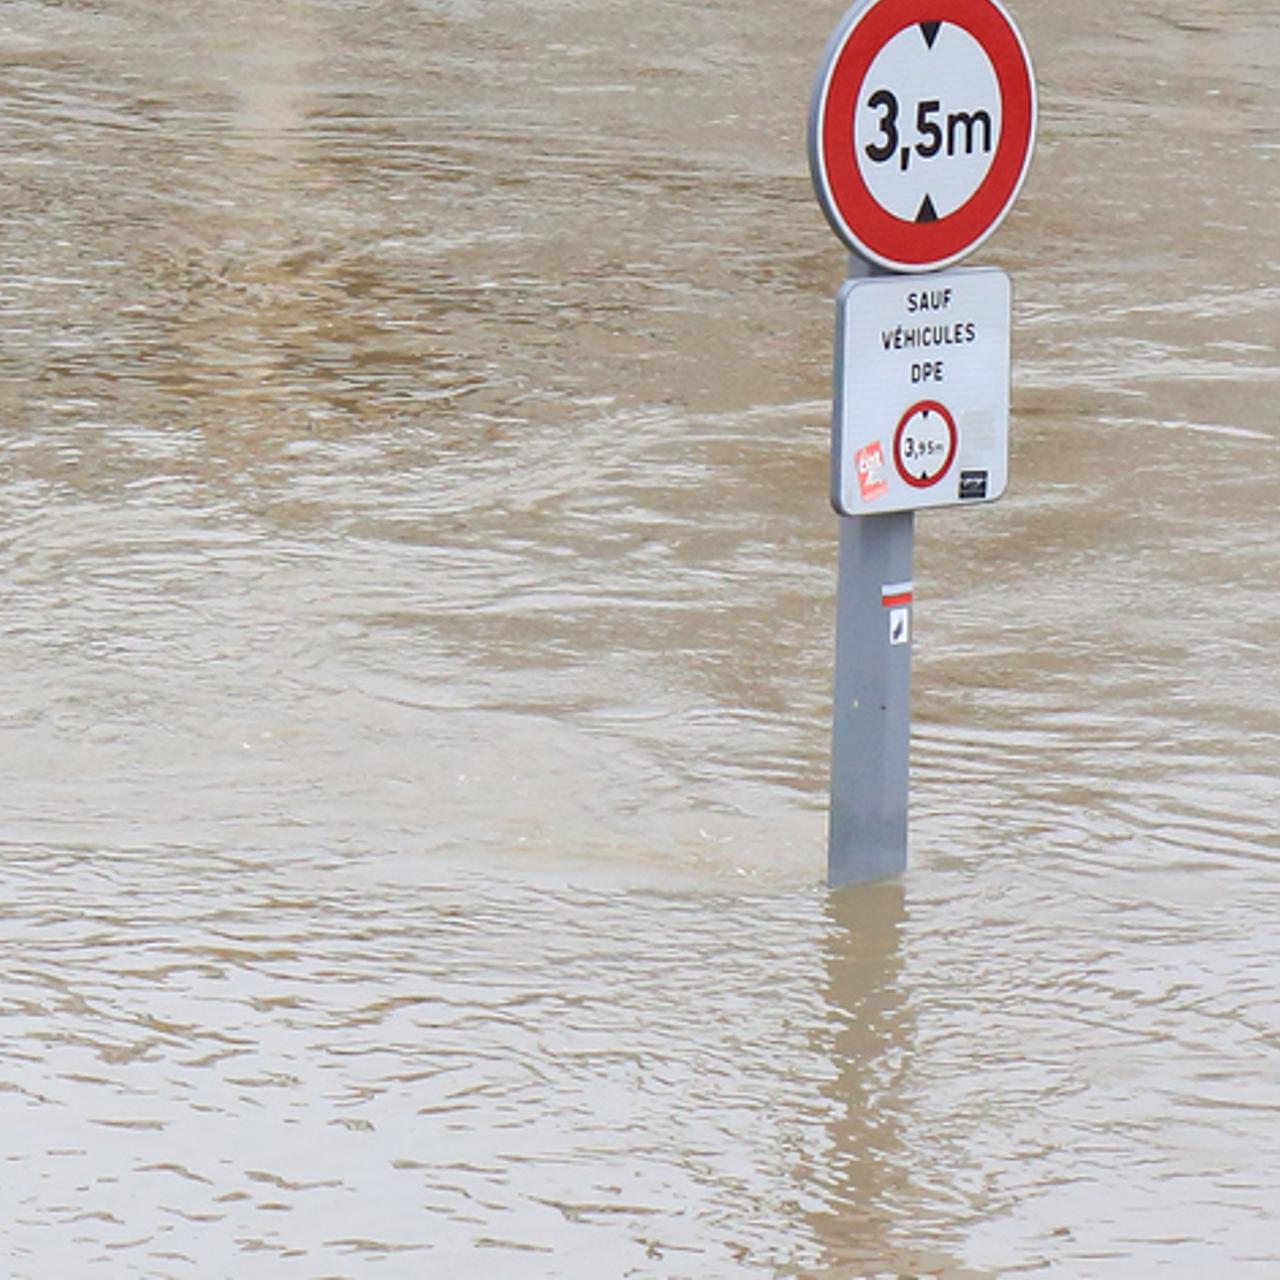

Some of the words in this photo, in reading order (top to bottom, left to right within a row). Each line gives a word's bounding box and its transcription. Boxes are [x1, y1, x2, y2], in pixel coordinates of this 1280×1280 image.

[864, 88, 992, 171] 3,5m
[906, 288, 952, 313] SAUF
[881, 322, 976, 351] VÉHICULES
[910, 361, 944, 384] DPE
